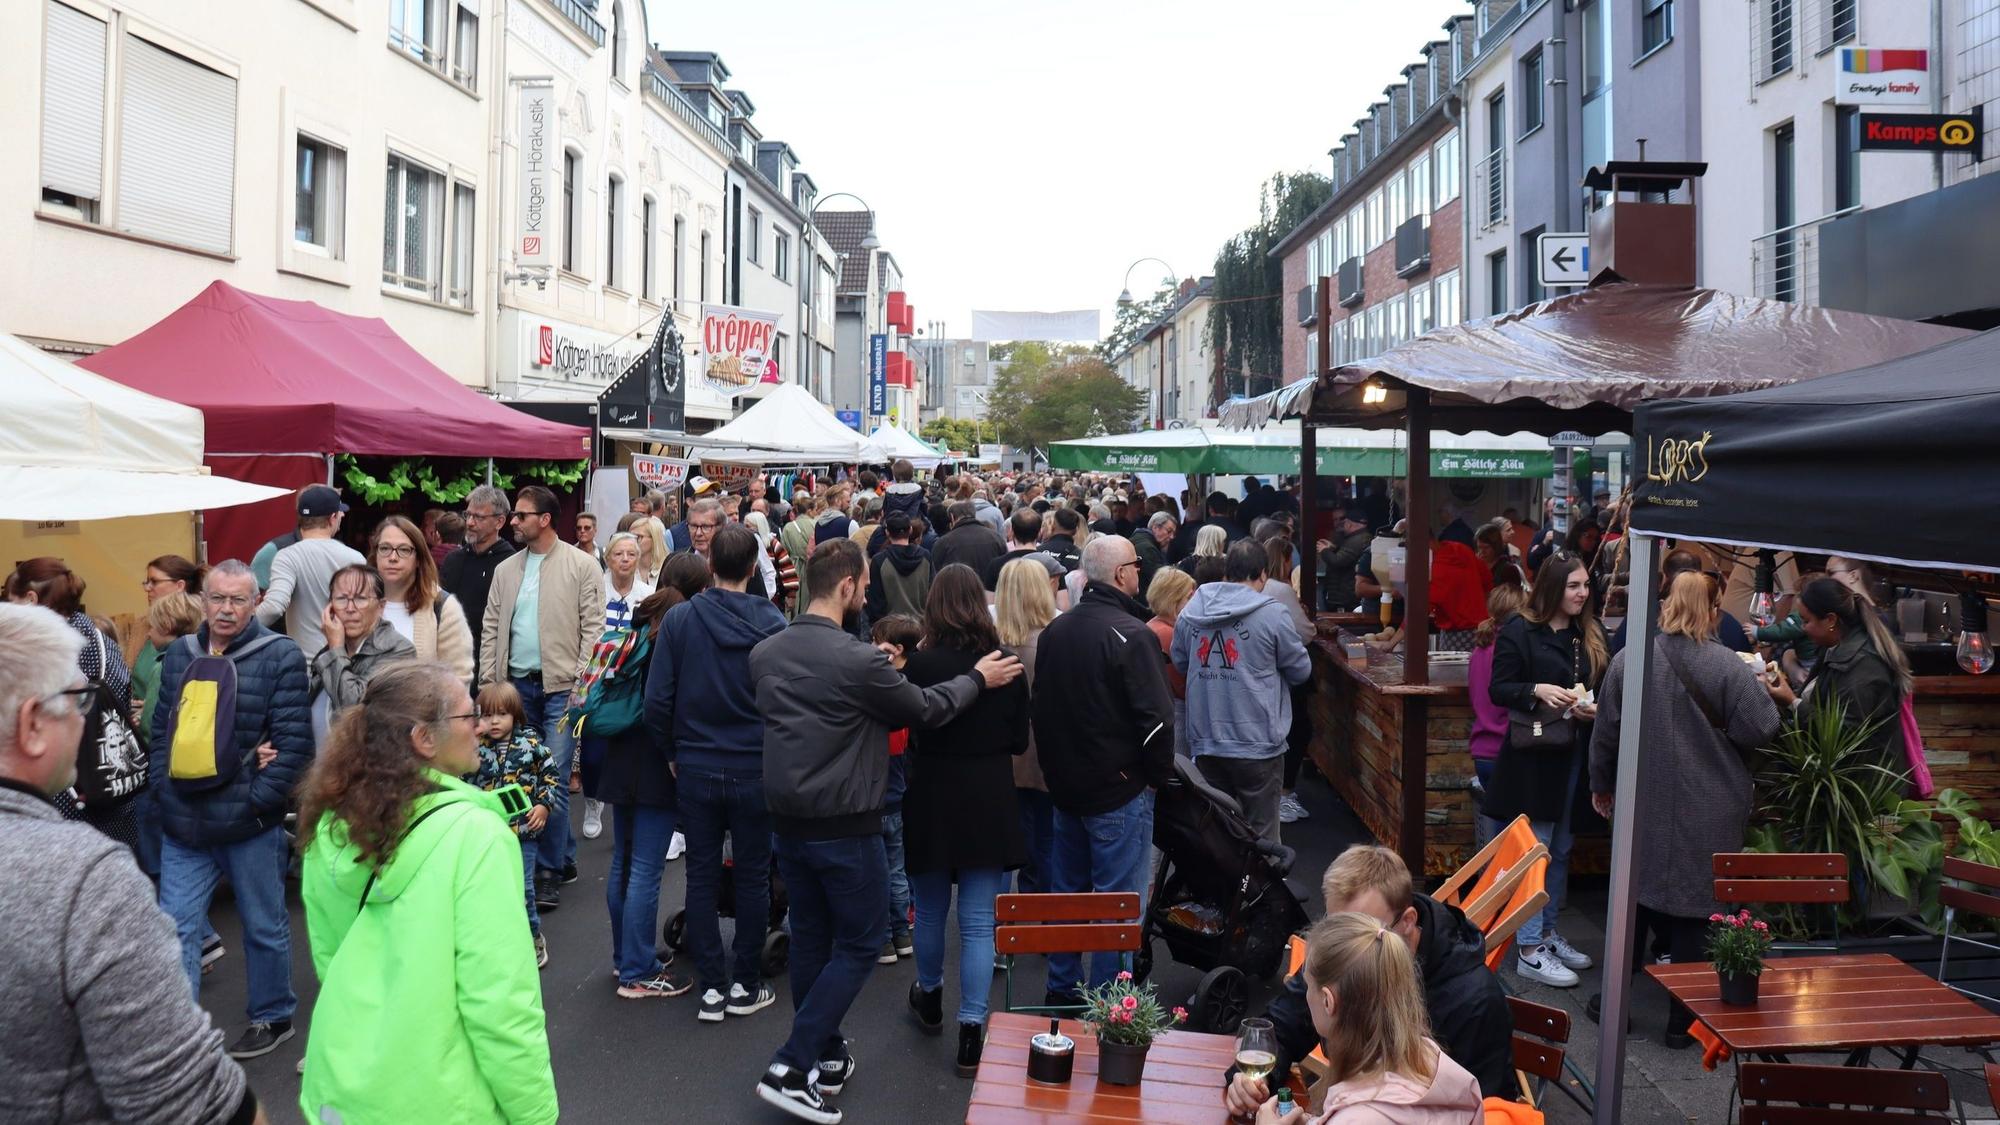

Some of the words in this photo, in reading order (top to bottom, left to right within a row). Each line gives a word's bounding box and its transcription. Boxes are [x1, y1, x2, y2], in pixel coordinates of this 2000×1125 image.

[1888, 82, 1920, 95] family
[527, 98, 544, 172] Hörakustik
[1867, 121, 1937, 144] Kamps
[526, 177, 544, 232] Köttgen
[555, 334, 591, 377] Köttgen
[704, 313, 773, 358] Crêpes
[875, 337, 883, 381] HÖRGERÄTE
[874, 384, 882, 412] KIND
[1500, 458, 1524, 471] Köln
